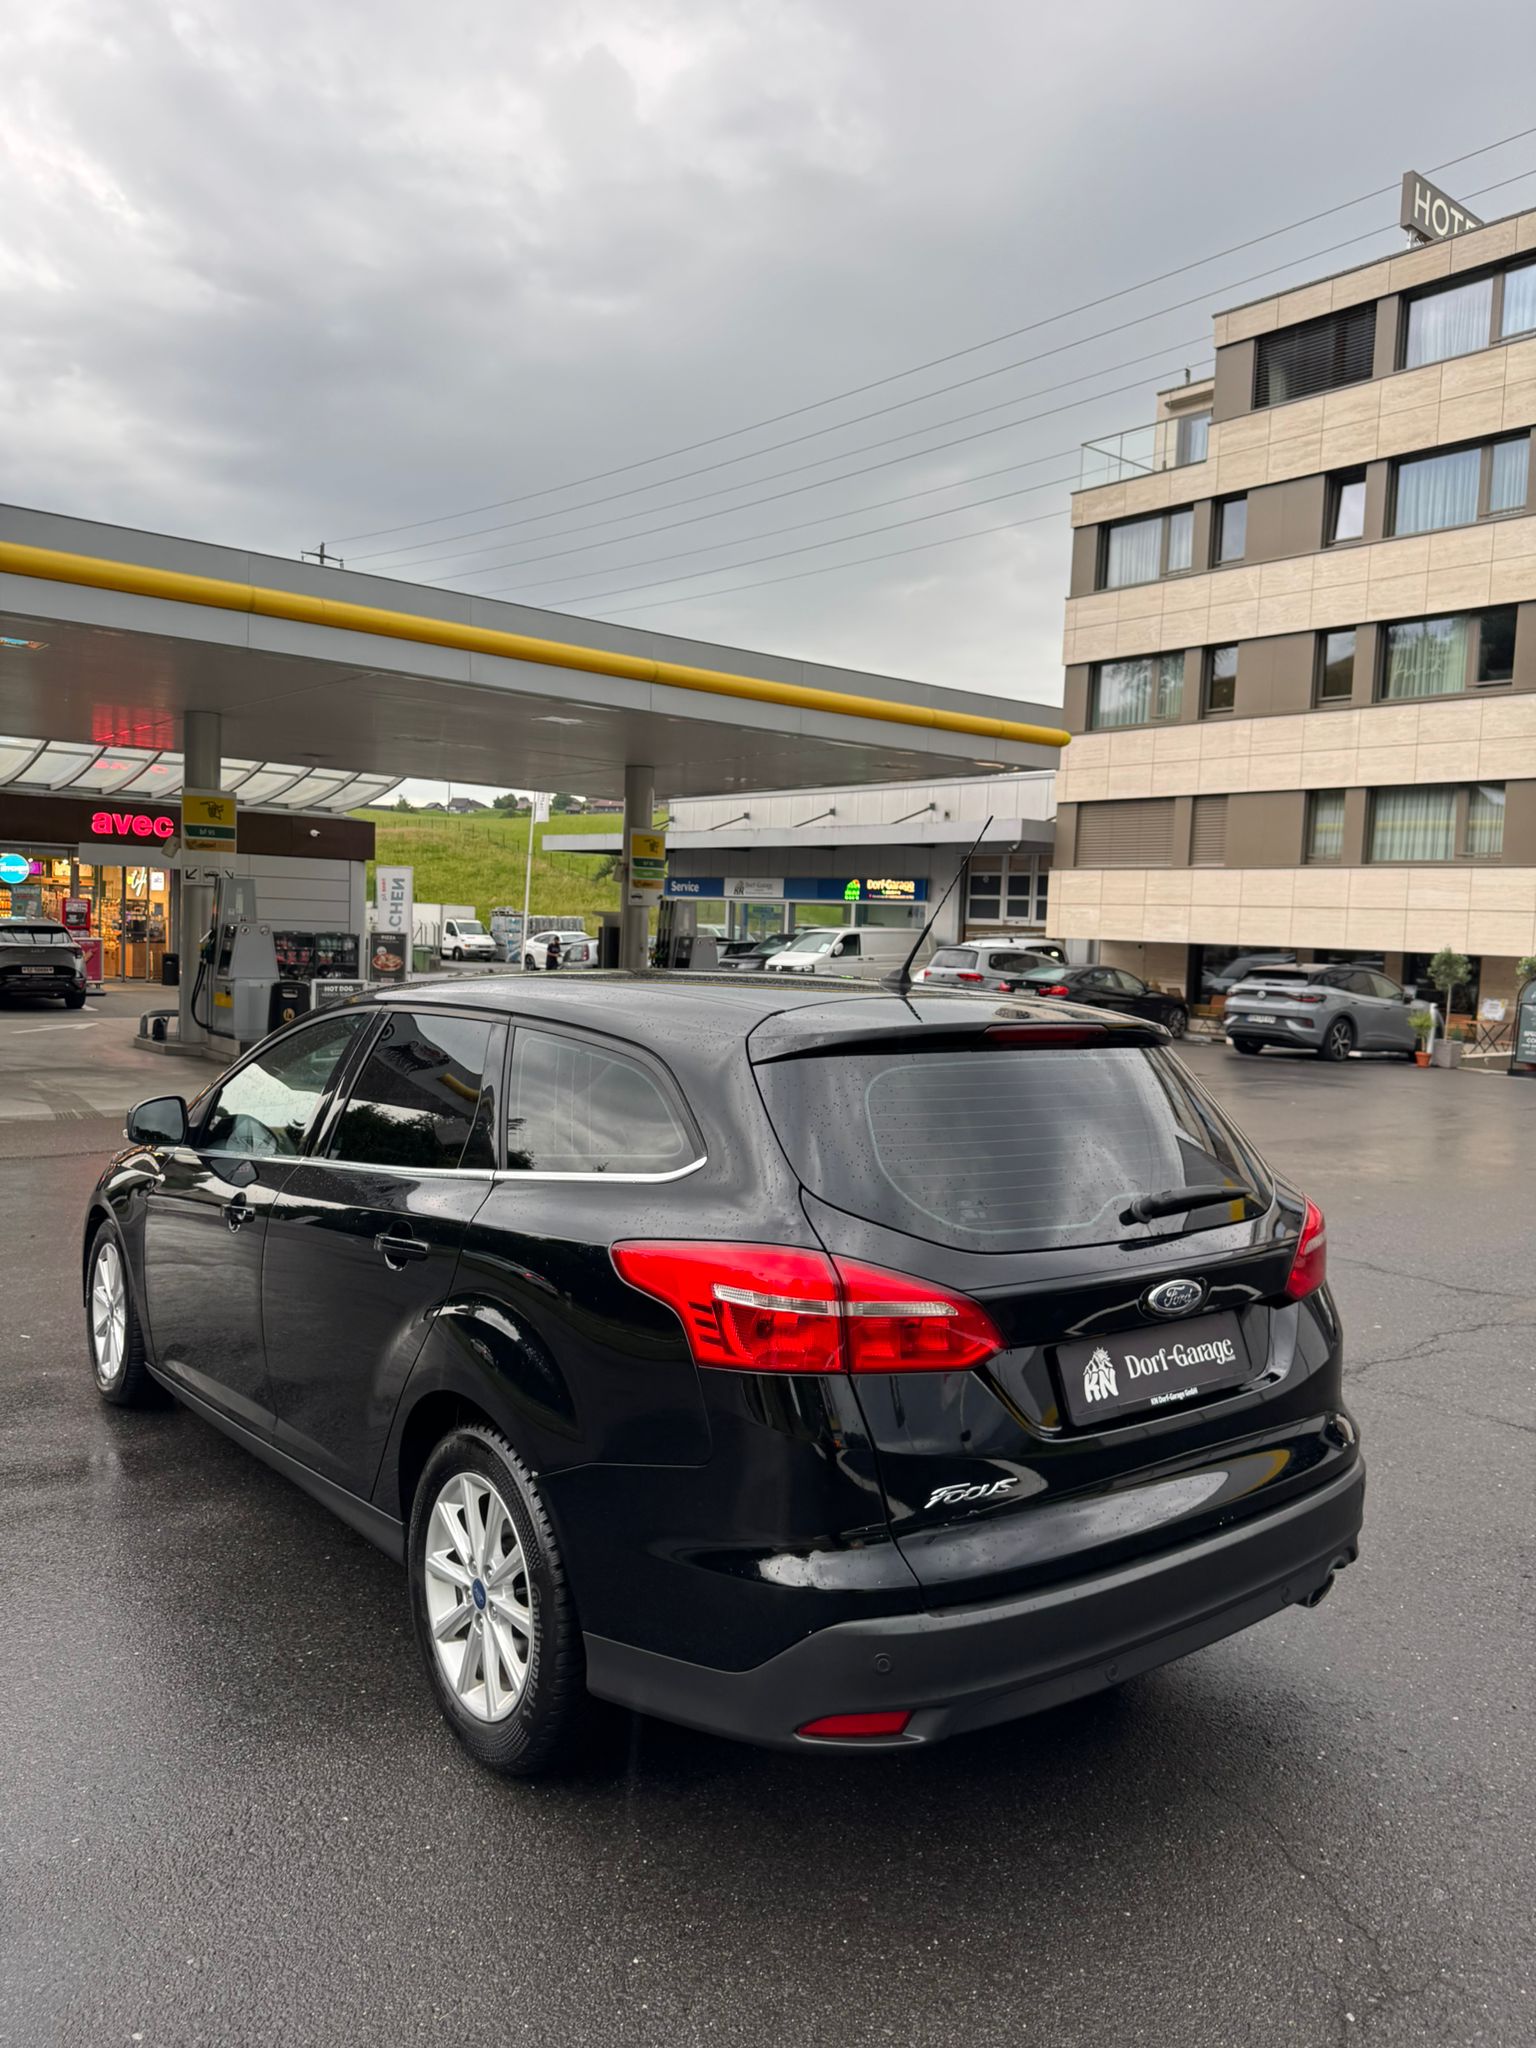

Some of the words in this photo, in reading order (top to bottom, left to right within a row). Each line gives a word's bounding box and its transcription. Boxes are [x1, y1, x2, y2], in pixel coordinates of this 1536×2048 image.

[1414, 182, 1477, 236] HOT
[91, 812, 174, 838] avec
[671, 880, 700, 893] Service
[1163, 1285, 1193, 1308] Ford
[1124, 1338, 1234, 1380] Dorf-Garage
[1083, 1368, 1119, 1403] KN
